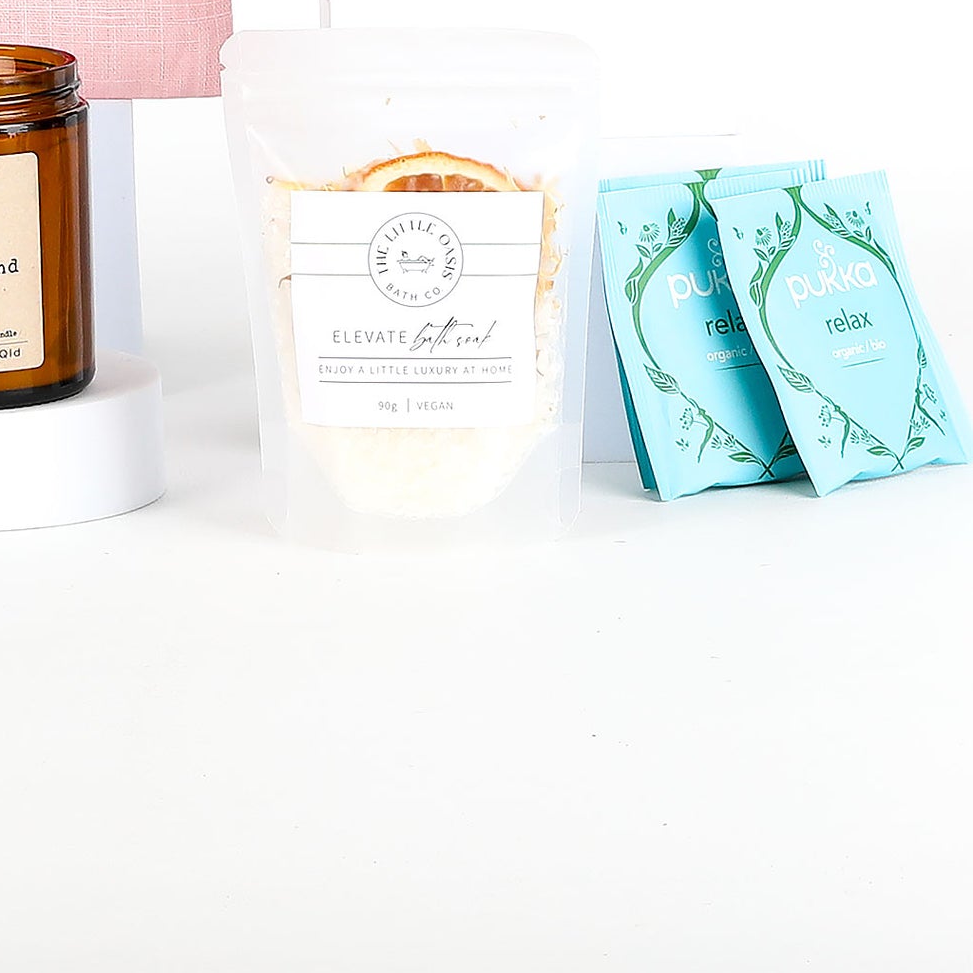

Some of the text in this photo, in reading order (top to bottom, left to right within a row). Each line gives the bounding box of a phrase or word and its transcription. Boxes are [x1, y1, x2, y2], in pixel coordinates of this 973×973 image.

[667, 238, 732, 309] puk
[784, 237, 879, 309] pukka
[386, 283, 418, 301] BATH
[705, 309, 747, 337] rela
[825, 307, 873, 335] relax
[333, 330, 407, 344] ELEVATE
[707, 345, 747, 363] organic
[832, 341, 865, 360] organic
[870, 338, 887, 352] bio
[318, 364, 513, 375] ENJOY A LITTLE LUXURY AT HOME
[378, 400, 454, 412] 90g VEGAN
